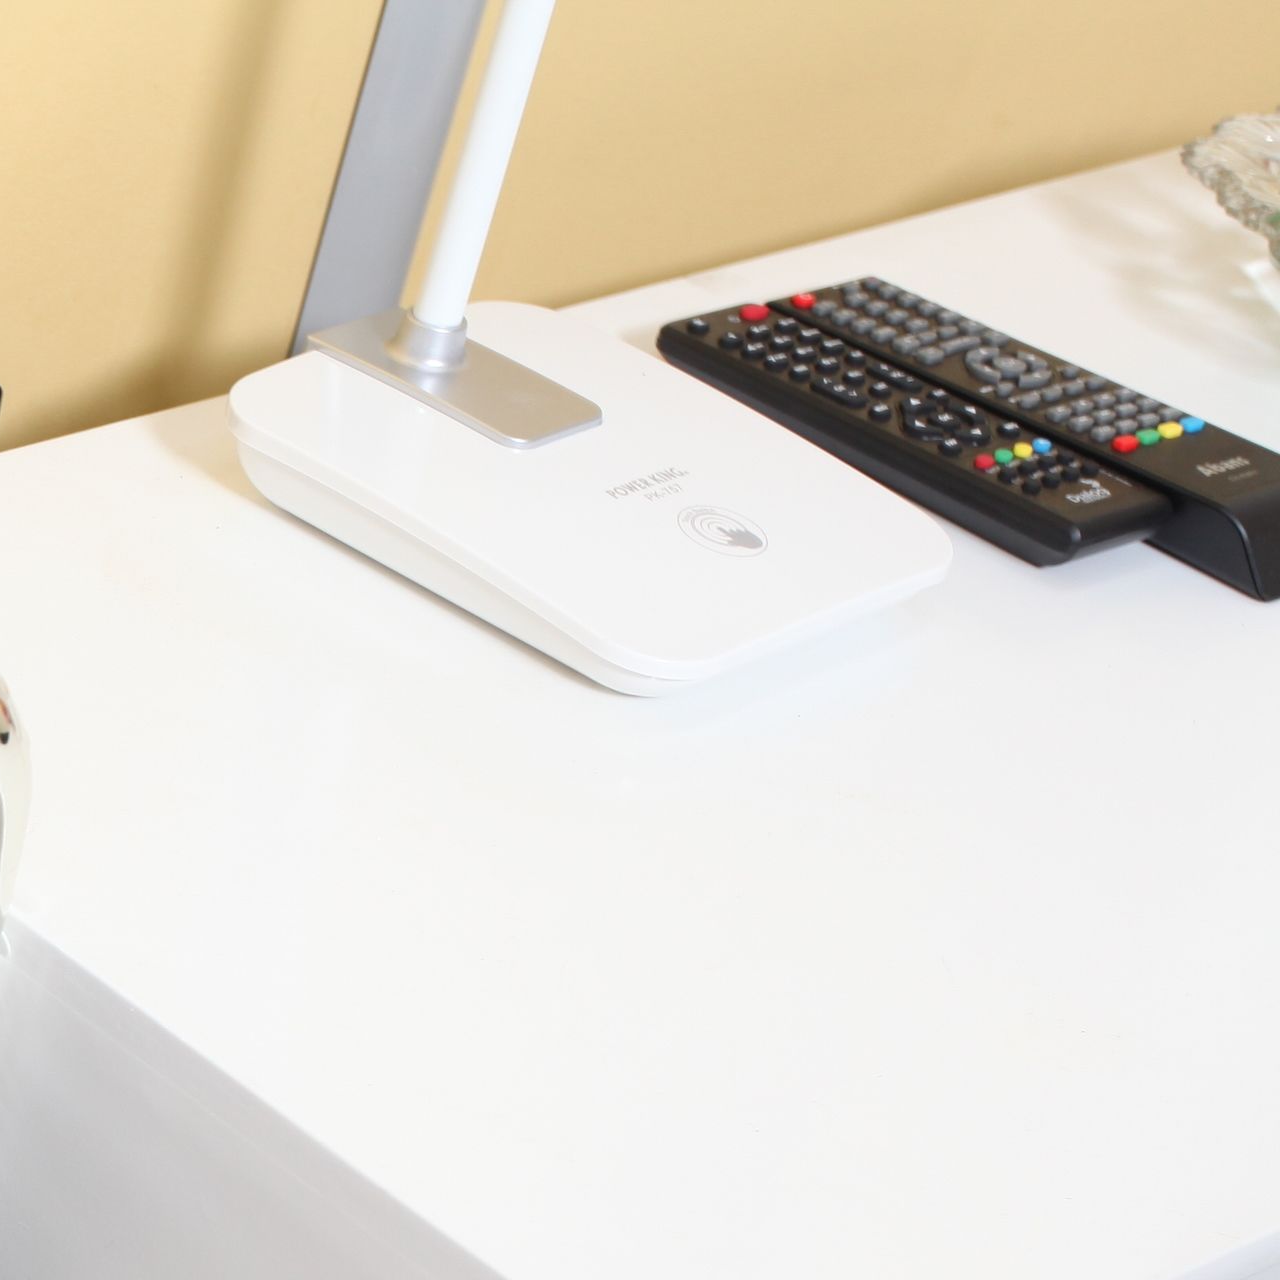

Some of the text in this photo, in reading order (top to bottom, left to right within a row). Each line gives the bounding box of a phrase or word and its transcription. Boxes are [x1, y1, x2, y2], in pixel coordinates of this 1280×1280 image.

[1196, 456, 1250, 477] Abans
[605, 466, 684, 499] POWER KING
